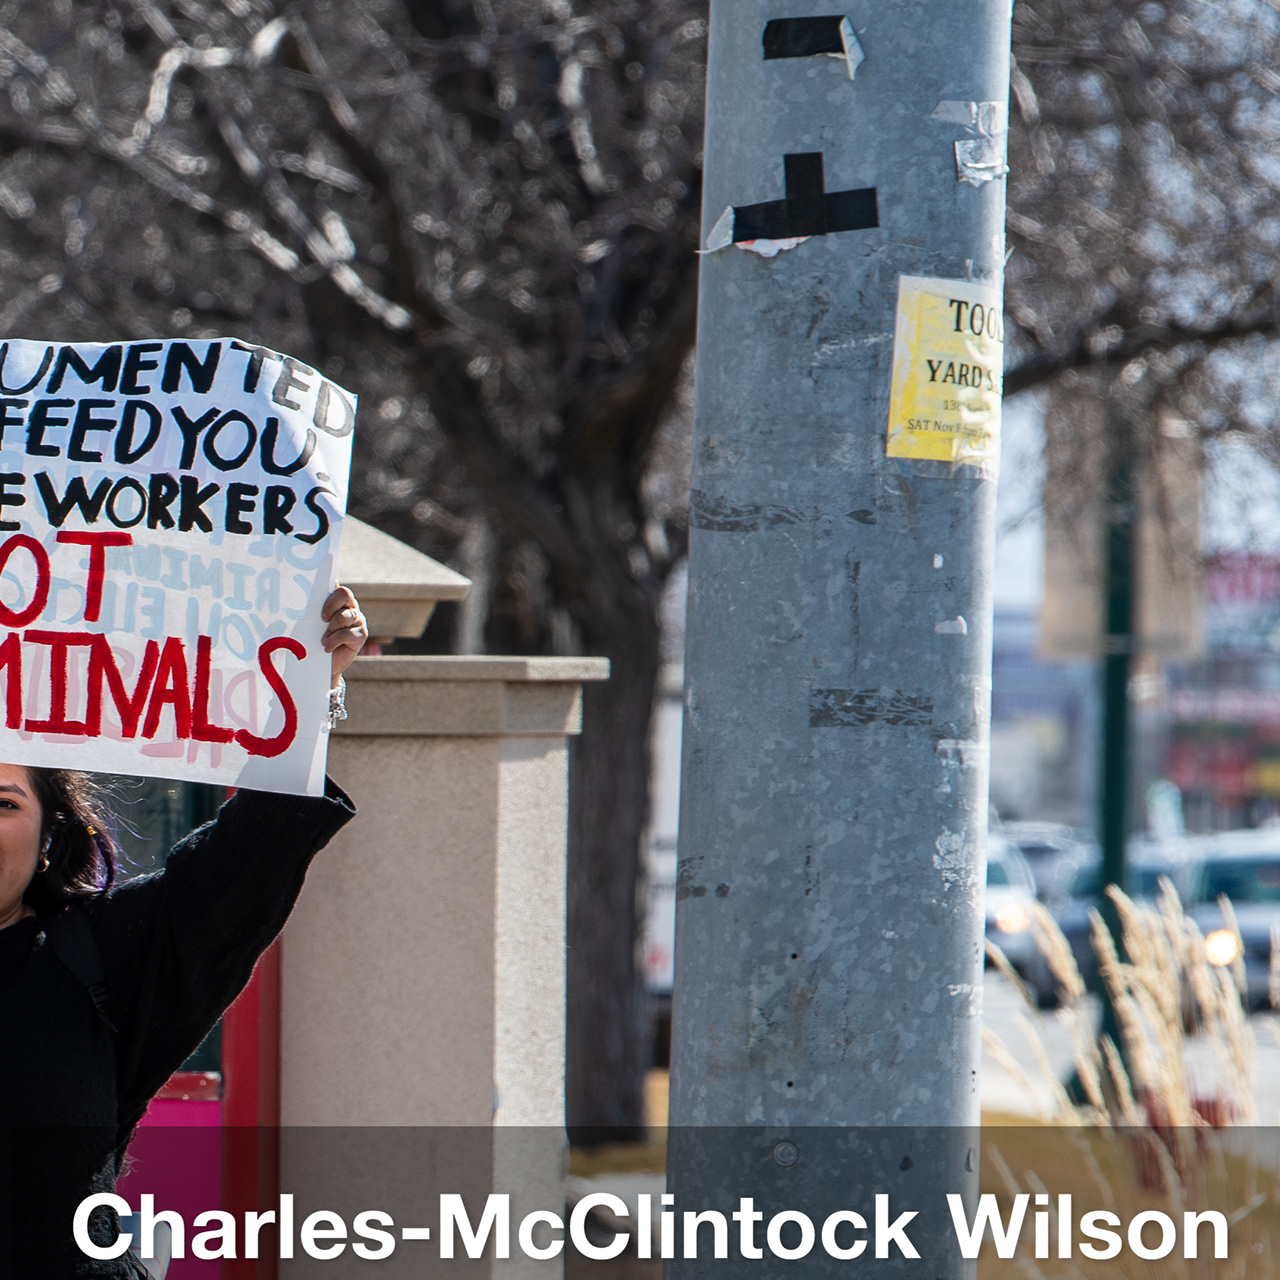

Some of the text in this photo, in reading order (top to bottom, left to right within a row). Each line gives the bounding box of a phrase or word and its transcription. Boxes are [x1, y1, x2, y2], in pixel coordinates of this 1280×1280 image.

[927, 359, 982, 388] YARD
[907, 419, 930, 430] SAT
[35, 471, 338, 545] WORKERS
